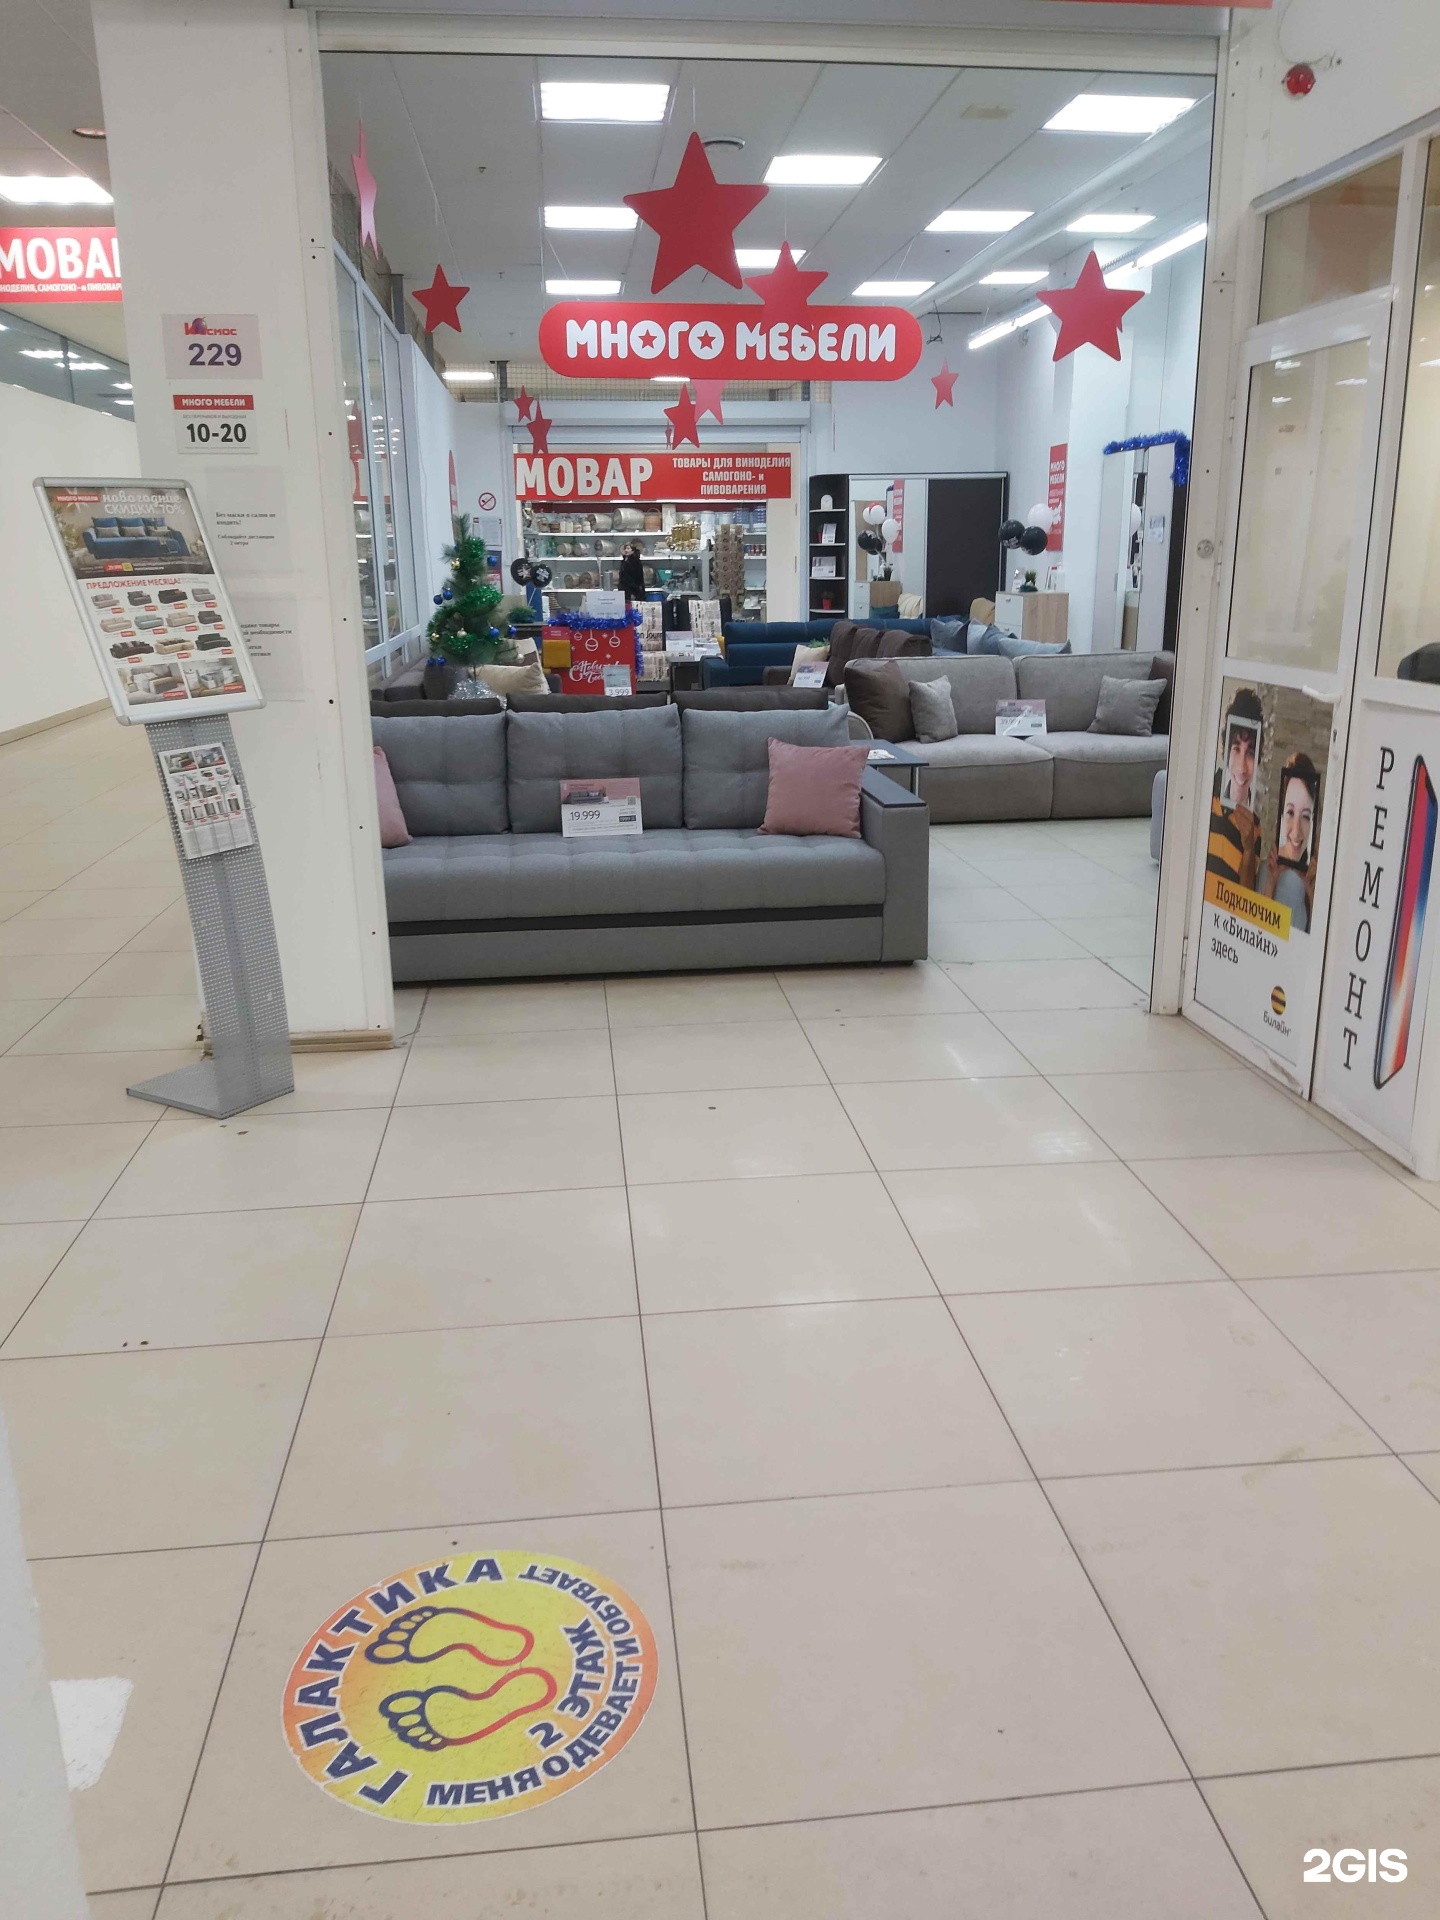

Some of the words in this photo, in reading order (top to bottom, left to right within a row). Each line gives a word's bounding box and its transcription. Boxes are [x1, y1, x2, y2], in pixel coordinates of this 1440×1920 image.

[188, 343, 242, 366] 229
[566, 319, 725, 360] МНОГО
[735, 321, 896, 362] МЕБЕЛИ
[181, 398, 213, 406] МНОГО
[214, 398, 246, 406] МЕБЕЛИ
[186, 423, 247, 442] 10-20
[516, 457, 653, 496] МОВАР
[672, 457, 711, 468] ТОВАРЫ
[713, 458, 733, 469] ДЛЯ
[736, 457, 791, 469] ВИНОДЕЛИЯ
[702, 471, 756, 481] САМОГОНО-
[700, 484, 767, 495] ПИВОВАРЕНИЯ
[104, 504, 154, 515] СКИДКИ
[86, 579, 147, 590] ПРЕДЛОЖЕНИЕ
[1215, 880, 1281, 929] Подключим
[1342, 746, 1395, 1071] РЕМОНТ
[1211, 938, 1239, 964] здесь
[1213, 913, 1220, 929] к
[1222, 915, 1278, 958] «Билайн»
[518, 1564, 632, 1636] ОБУВАЕТ
[298, 1557, 503, 1805] ГАЛАКТИКА
[528, 1721, 565, 1750] 2
[557, 1618, 607, 1720] ЭТАЖ
[542, 1662, 641, 1778] ОДЕВАЕТ
[426, 1766, 543, 1806] МЕНЯ
